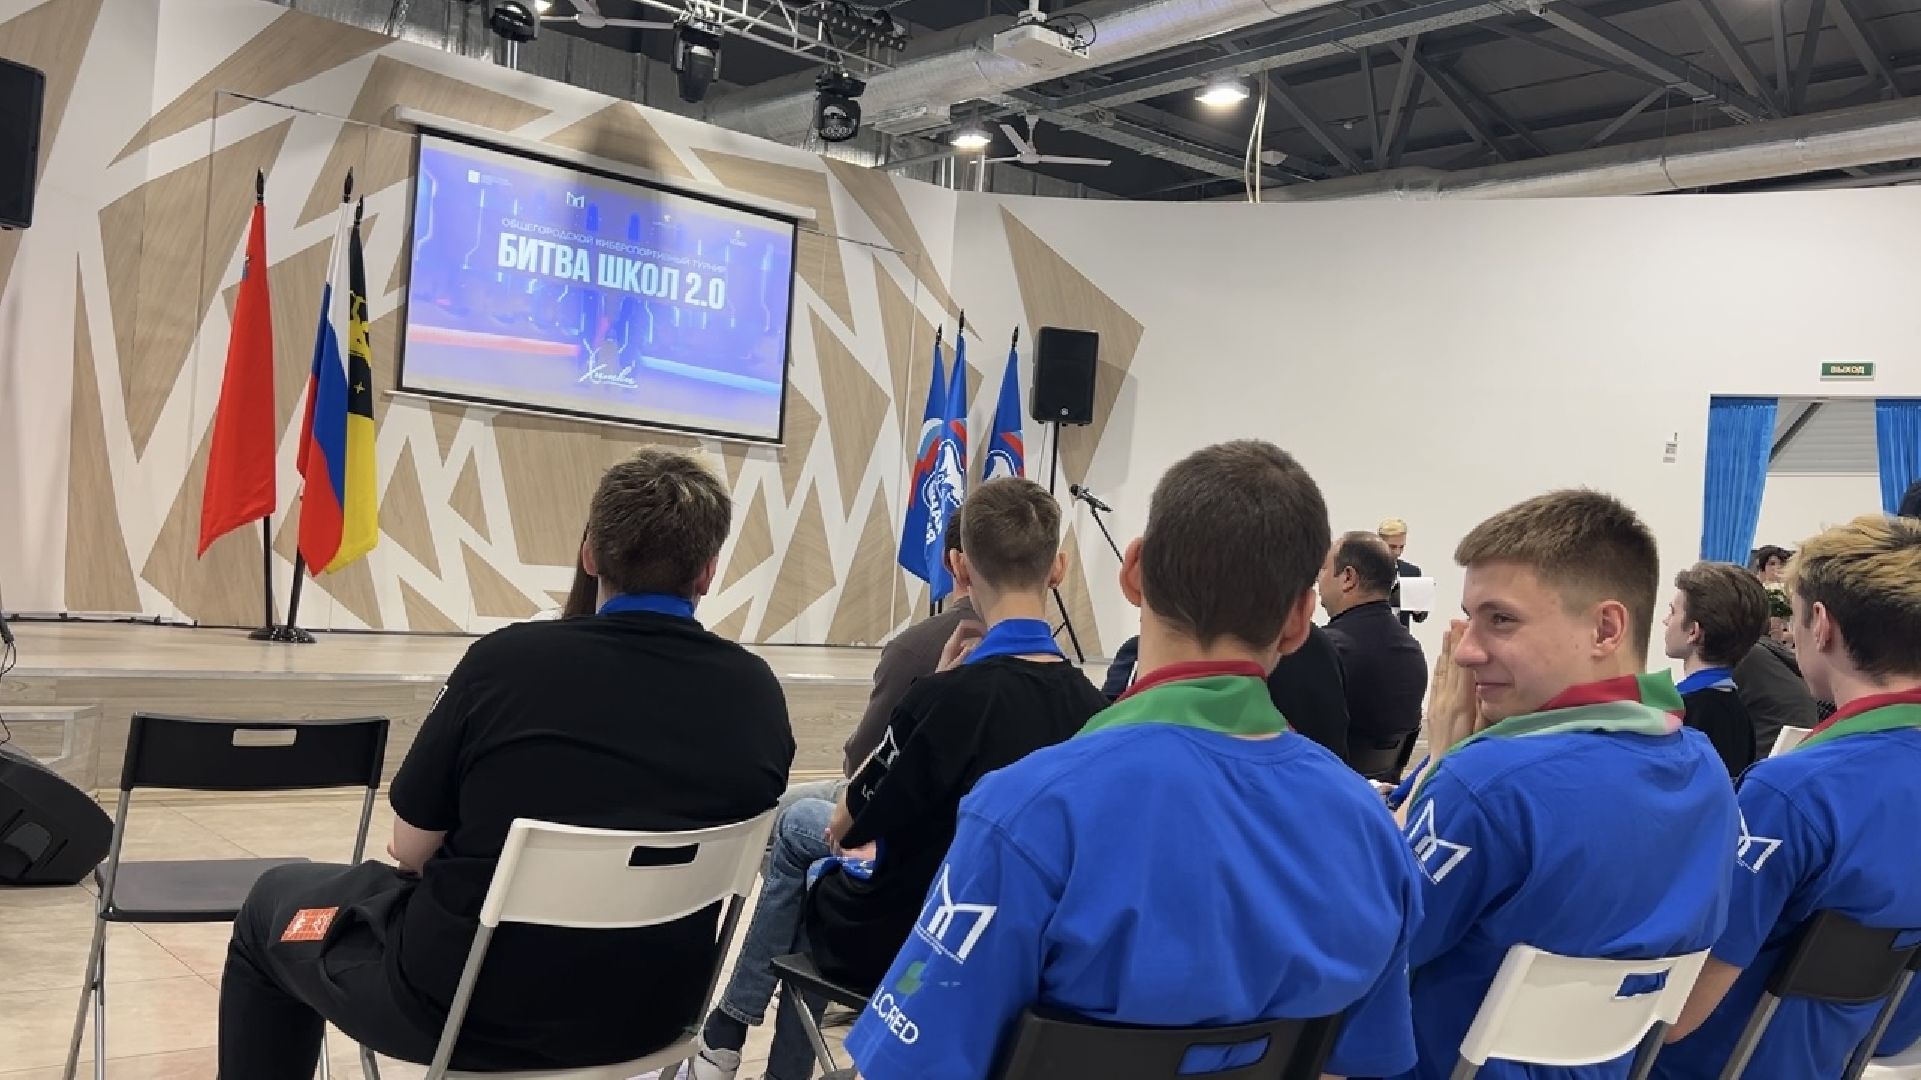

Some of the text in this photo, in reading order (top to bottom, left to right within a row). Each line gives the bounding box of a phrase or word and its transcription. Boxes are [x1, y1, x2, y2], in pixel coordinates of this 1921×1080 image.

[498, 232, 726, 310] БИТВА ШКОЛ 2.0
[596, 238, 687, 265] КИБЕРСПОРТИ
